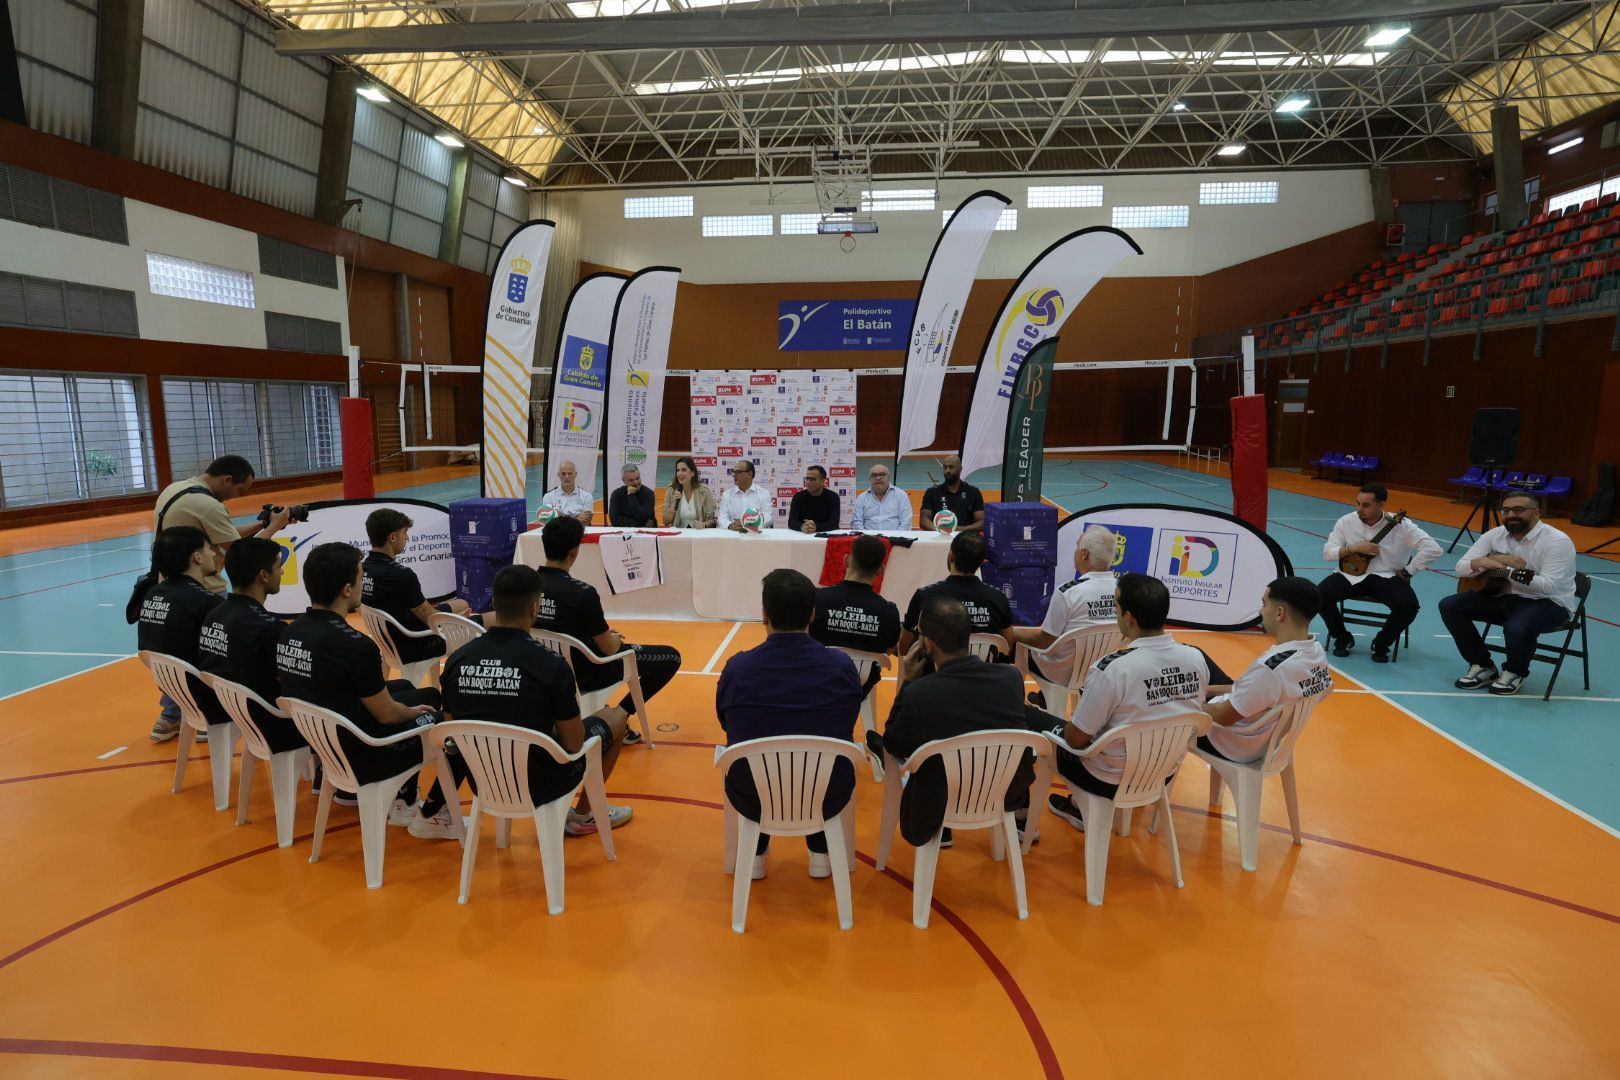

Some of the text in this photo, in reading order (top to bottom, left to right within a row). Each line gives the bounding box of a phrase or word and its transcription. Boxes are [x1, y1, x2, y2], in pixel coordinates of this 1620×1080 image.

[496, 311, 504, 320] de
[500, 305, 530, 318] Gobierno
[843, 307, 892, 316] Polideportivo
[843, 318, 892, 330] El Batán
[567, 369, 589, 379] Cabildo
[564, 375, 602, 387] Gran Canaria
[633, 390, 641, 416] Palmas
[624, 390, 634, 443] Ayuntamiento
[631, 434, 638, 444] de
[638, 435, 644, 444] de
[1019, 416, 1031, 477] LEADER
[420, 533, 450, 541] Promoc
[418, 542, 450, 551] Deporte
[418, 551, 453, 562] Canaria
[1172, 586, 1218, 598] DEPORTES
[1087, 600, 1113, 609] VOLEI
[967, 607, 990, 615] IBOL
[827, 618, 839, 627] SAN
[828, 609, 880, 625] VOLEIBOL
[460, 666, 521, 680] VOLEIBOL
[1161, 666, 1180, 675] CLUB
[458, 676, 470, 687] SAN
[471, 677, 493, 690] ROQUE
[496, 679, 520, 690] BATAN
[1144, 671, 1200, 689] VOLEIBOL
[1146, 688, 1159, 700] SAN
[1181, 682, 1200, 695] BATAN
